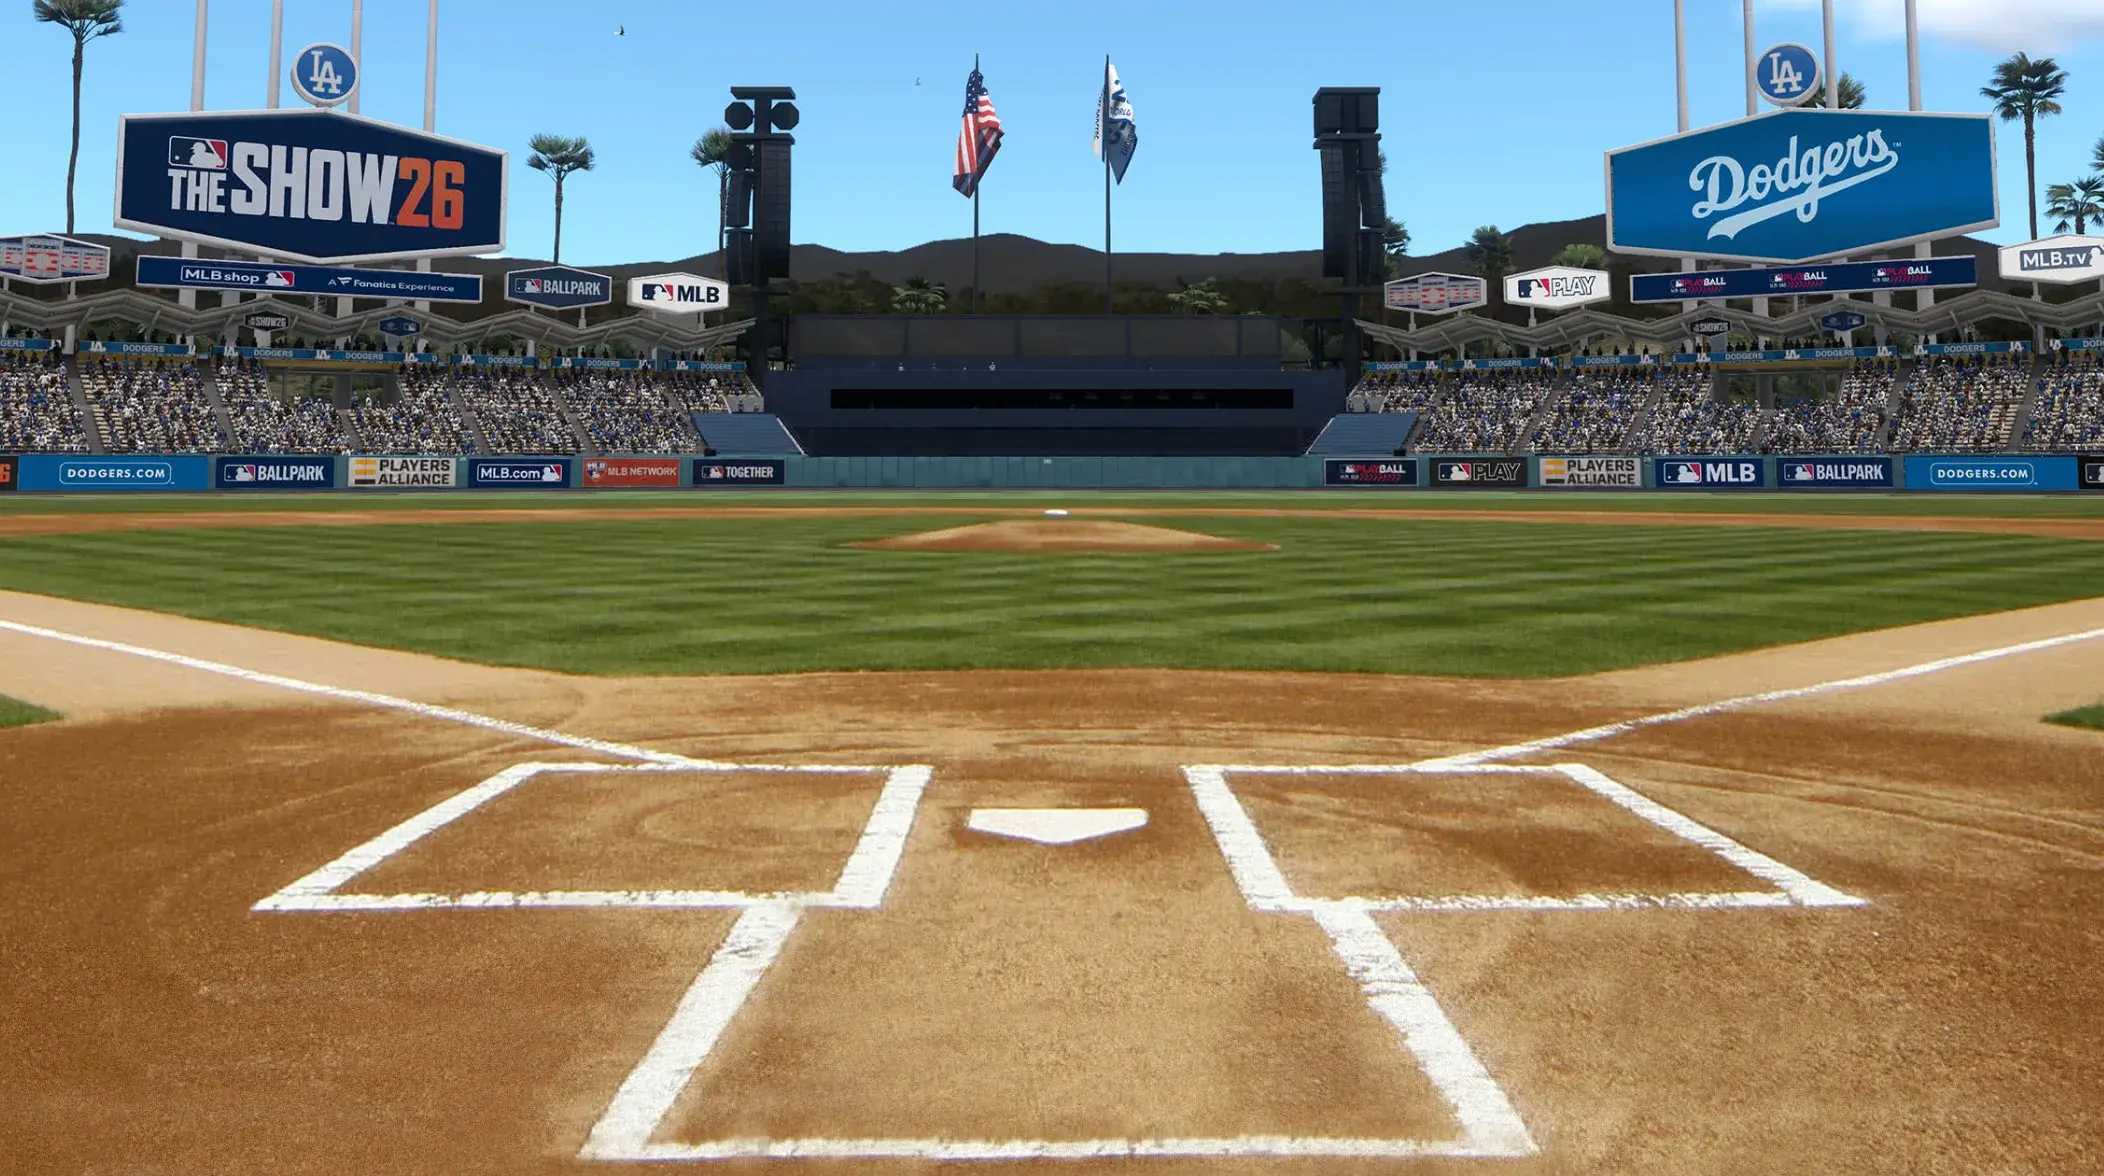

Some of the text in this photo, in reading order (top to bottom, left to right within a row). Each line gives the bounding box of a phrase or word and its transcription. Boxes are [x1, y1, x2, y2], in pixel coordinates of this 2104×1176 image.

[1689, 128, 1898, 230] Dodgers
[168, 142, 465, 230] THE SHOW 26
[2023, 252, 2086, 268] MLB.TV
[185, 269, 260, 284] MLB shop
[354, 279, 396, 289] Fanatics
[398, 282, 454, 292] Experience
[544, 280, 600, 296] BALLPARK
[1552, 276, 1596, 296] PLAY
[678, 285, 720, 303] MLB
[122, 344, 164, 352] DODGERS
[254, 349, 294, 357] DODGERS
[1943, 344, 1986, 352] DODGERS
[344, 352, 384, 360] DODGERS
[488, 356, 522, 364] DODGERS
[1725, 352, 1764, 360] DODGERS
[380, 460, 450, 472] PLAYERS
[608, 468, 676, 476] MLB NETWORK
[725, 466, 774, 478] TOGETHER
[1473, 463, 1520, 480] PLAY
[1567, 460, 1634, 472] PLAYERS
[1816, 464, 1884, 480] BALLPARK
[68, 469, 165, 478] DODGERS.COM
[258, 466, 324, 480] BALLPARK
[378, 474, 450, 484] ALLIANCE
[480, 468, 540, 479] MLB.com
[1567, 474, 1636, 484] ALLIANCE
[1706, 464, 1756, 482] MLB
[1938, 470, 2028, 478] DODGERS.COM
